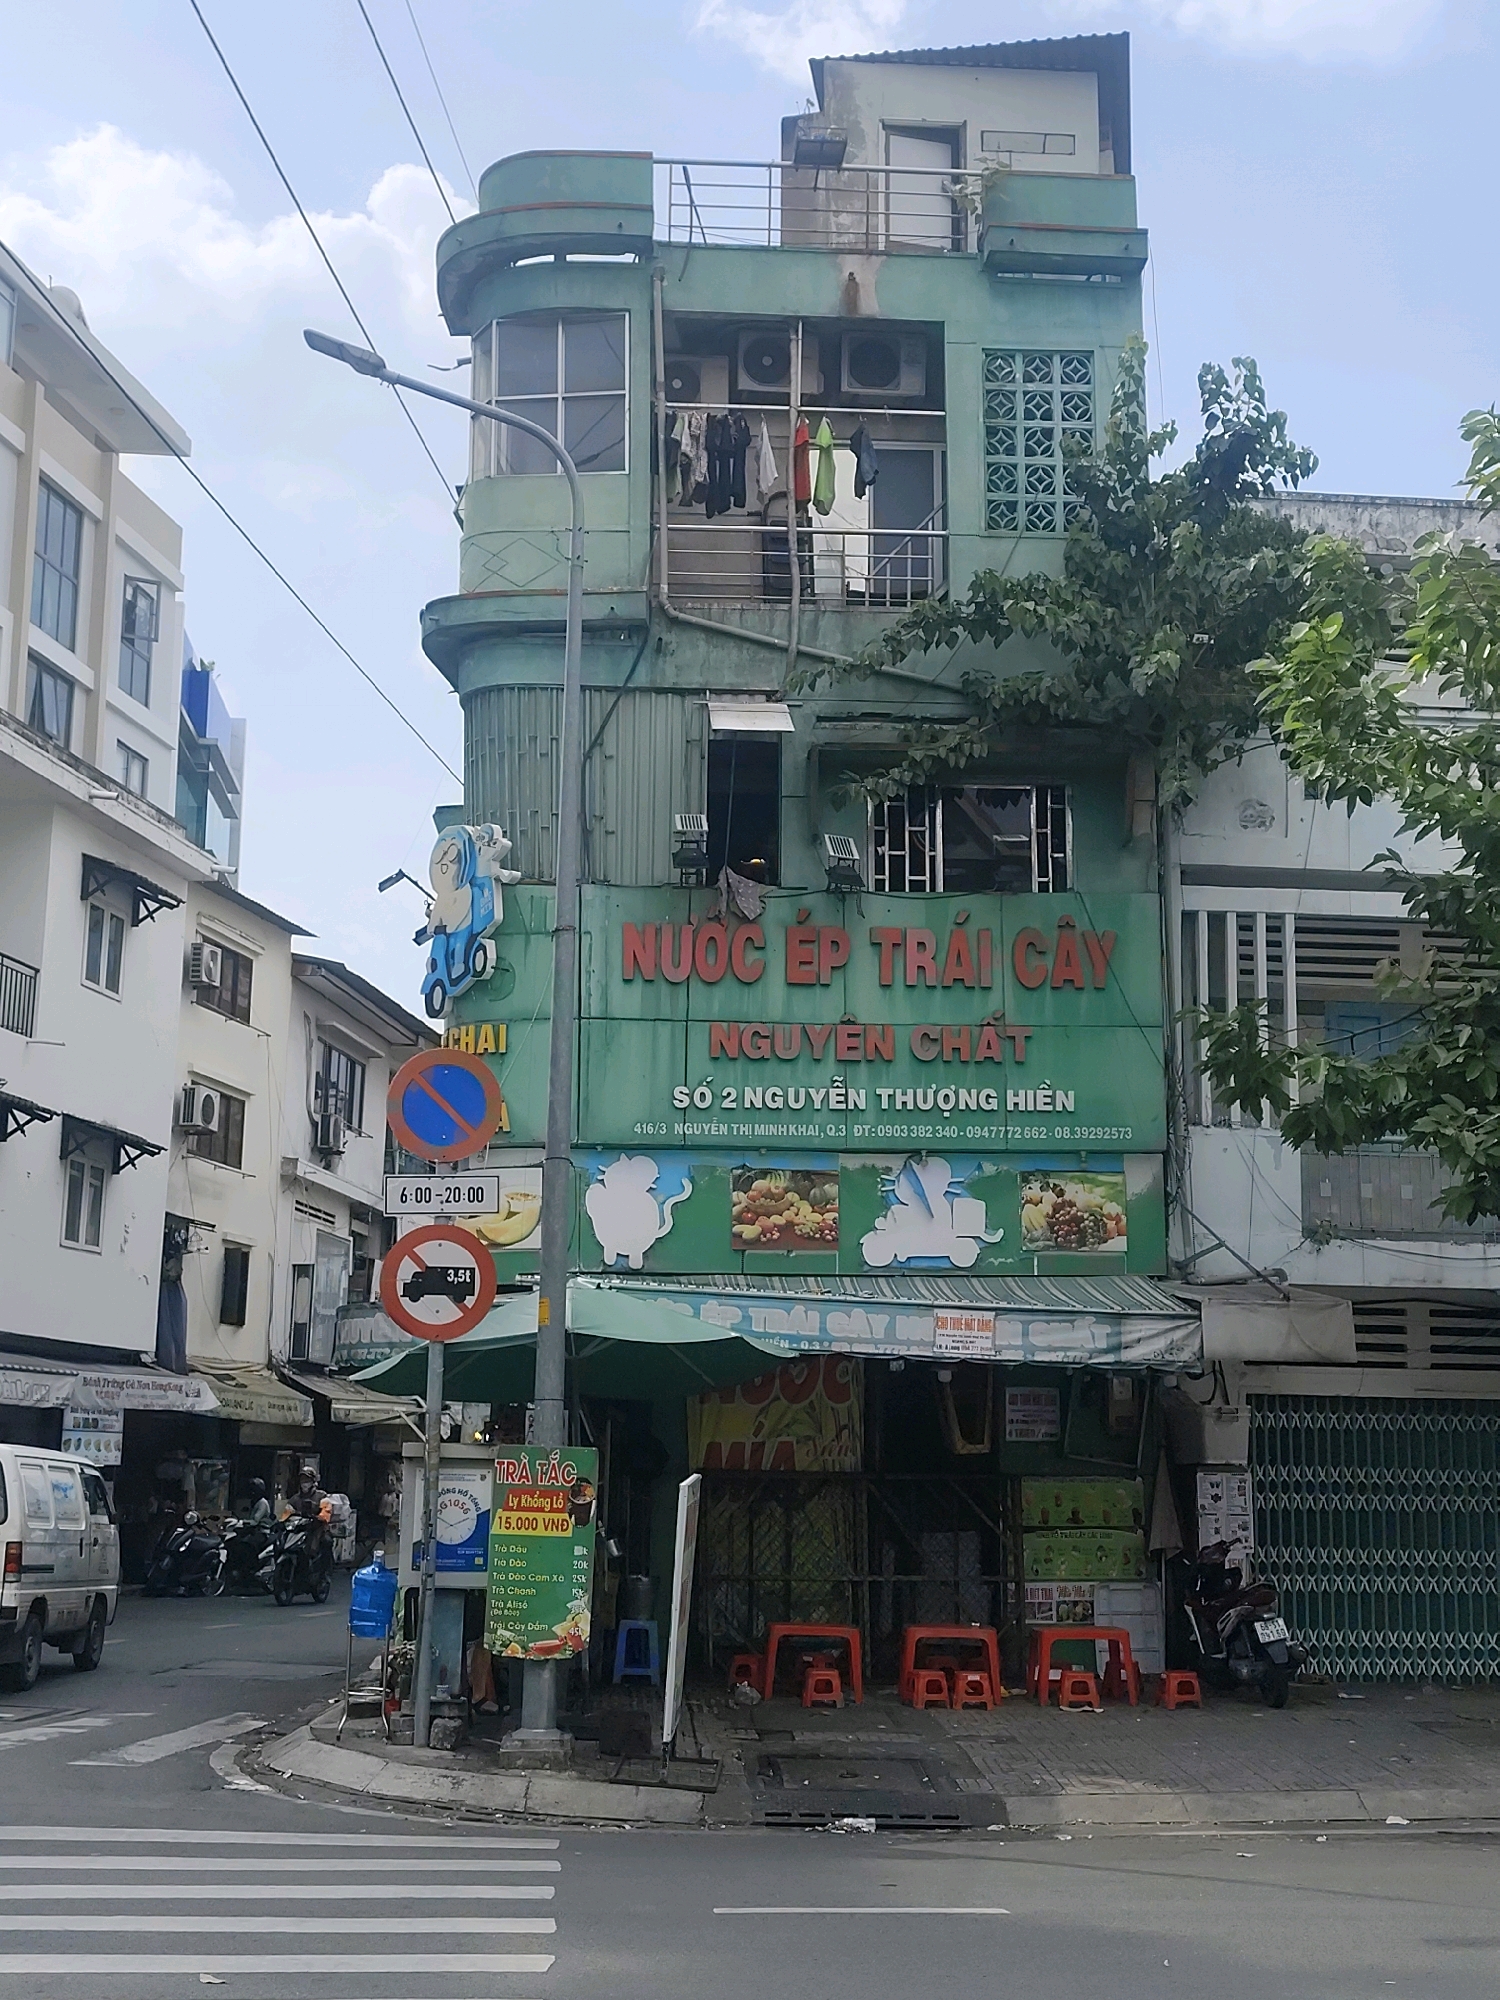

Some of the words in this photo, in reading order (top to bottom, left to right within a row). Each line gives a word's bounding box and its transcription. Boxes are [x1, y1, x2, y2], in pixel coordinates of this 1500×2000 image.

[786, 908, 851, 985] ÉP
[869, 910, 992, 989] TRÁI
[1013, 914, 1117, 989] CÂY
[709, 1012, 895, 1061] NGUYÊN
[910, 1009, 1033, 1064] CHẤT
[672, 1075, 714, 1110] SỐ
[721, 1086, 737, 1109] 2
[744, 1075, 867, 1110] NGUYỄN
[875, 1083, 998, 1117] THƯỢNG
[1006, 1079, 1075, 1112] HIỀN
[633, 1122, 667, 1135] 416/3
[674, 1117, 728, 1136] NGUYỄN
[826, 1124, 846, 1137] Q.3
[447, 1269, 471, 1284] 3,5t
[495, 1452, 532, 1484] TRÀ
[536, 1449, 577, 1486] TẮC
[508, 1494, 519, 1510] Ly
[520, 1490, 551, 1512] Khổng
[498, 1516, 538, 1531] 15.000
[542, 1517, 569, 1532] VNĐ
[494, 1544, 507, 1553] Trà
[494, 1558, 506, 1567] Trà
[572, 1560, 589, 1569] 20k
[492, 1571, 506, 1580] Trà
[528, 1573, 550, 1582] Cam
[572, 1574, 587, 1583] 25k
[491, 1585, 505, 1594] Trà
[507, 1586, 536, 1596] Chanh
